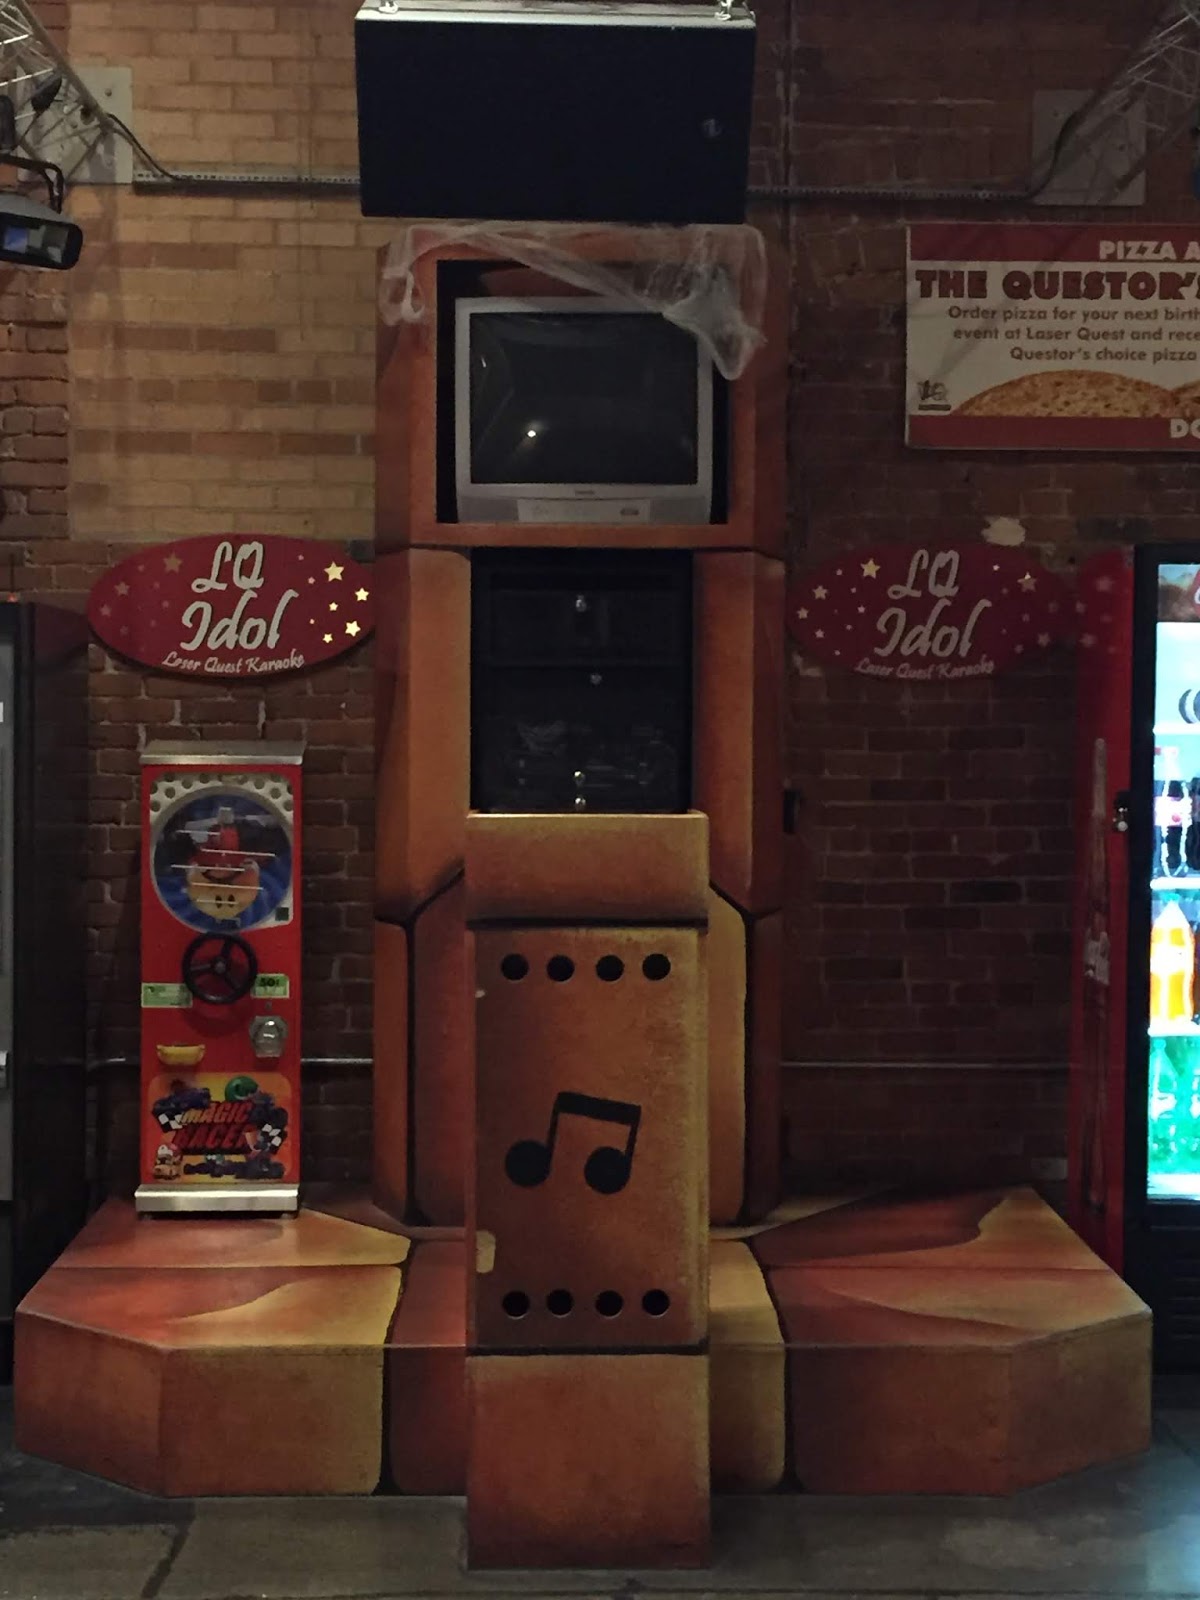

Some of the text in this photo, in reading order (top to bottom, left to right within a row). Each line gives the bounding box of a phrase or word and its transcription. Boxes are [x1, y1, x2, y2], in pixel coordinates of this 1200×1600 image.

[1099, 240, 1177, 260] PIZZA
[915, 269, 1200, 300] THE QUESTOR'
[948, 305, 997, 319] Order
[1003, 306, 1047, 323] pizza
[1052, 305, 1076, 320] for
[1082, 309, 1118, 323] your
[1124, 307, 1158, 321] next
[953, 327, 999, 340] event
[1005, 327, 1022, 340] at
[1027, 326, 1071, 341] Laser
[1077, 327, 1125, 342] Quest
[1130, 327, 1163, 341] and
[1010, 347, 1197, 364] Questor's choice pizza
[191, 541, 264, 593] LQ
[887, 549, 961, 600] LQ
[180, 589, 299, 651] Idol
[873, 598, 993, 658] Idol
[162, 649, 306, 673] Laser Quest Karaoke
[854, 653, 996, 680] Laser Quest Karaoke
[180, 1100, 253, 1124] MAGIC
